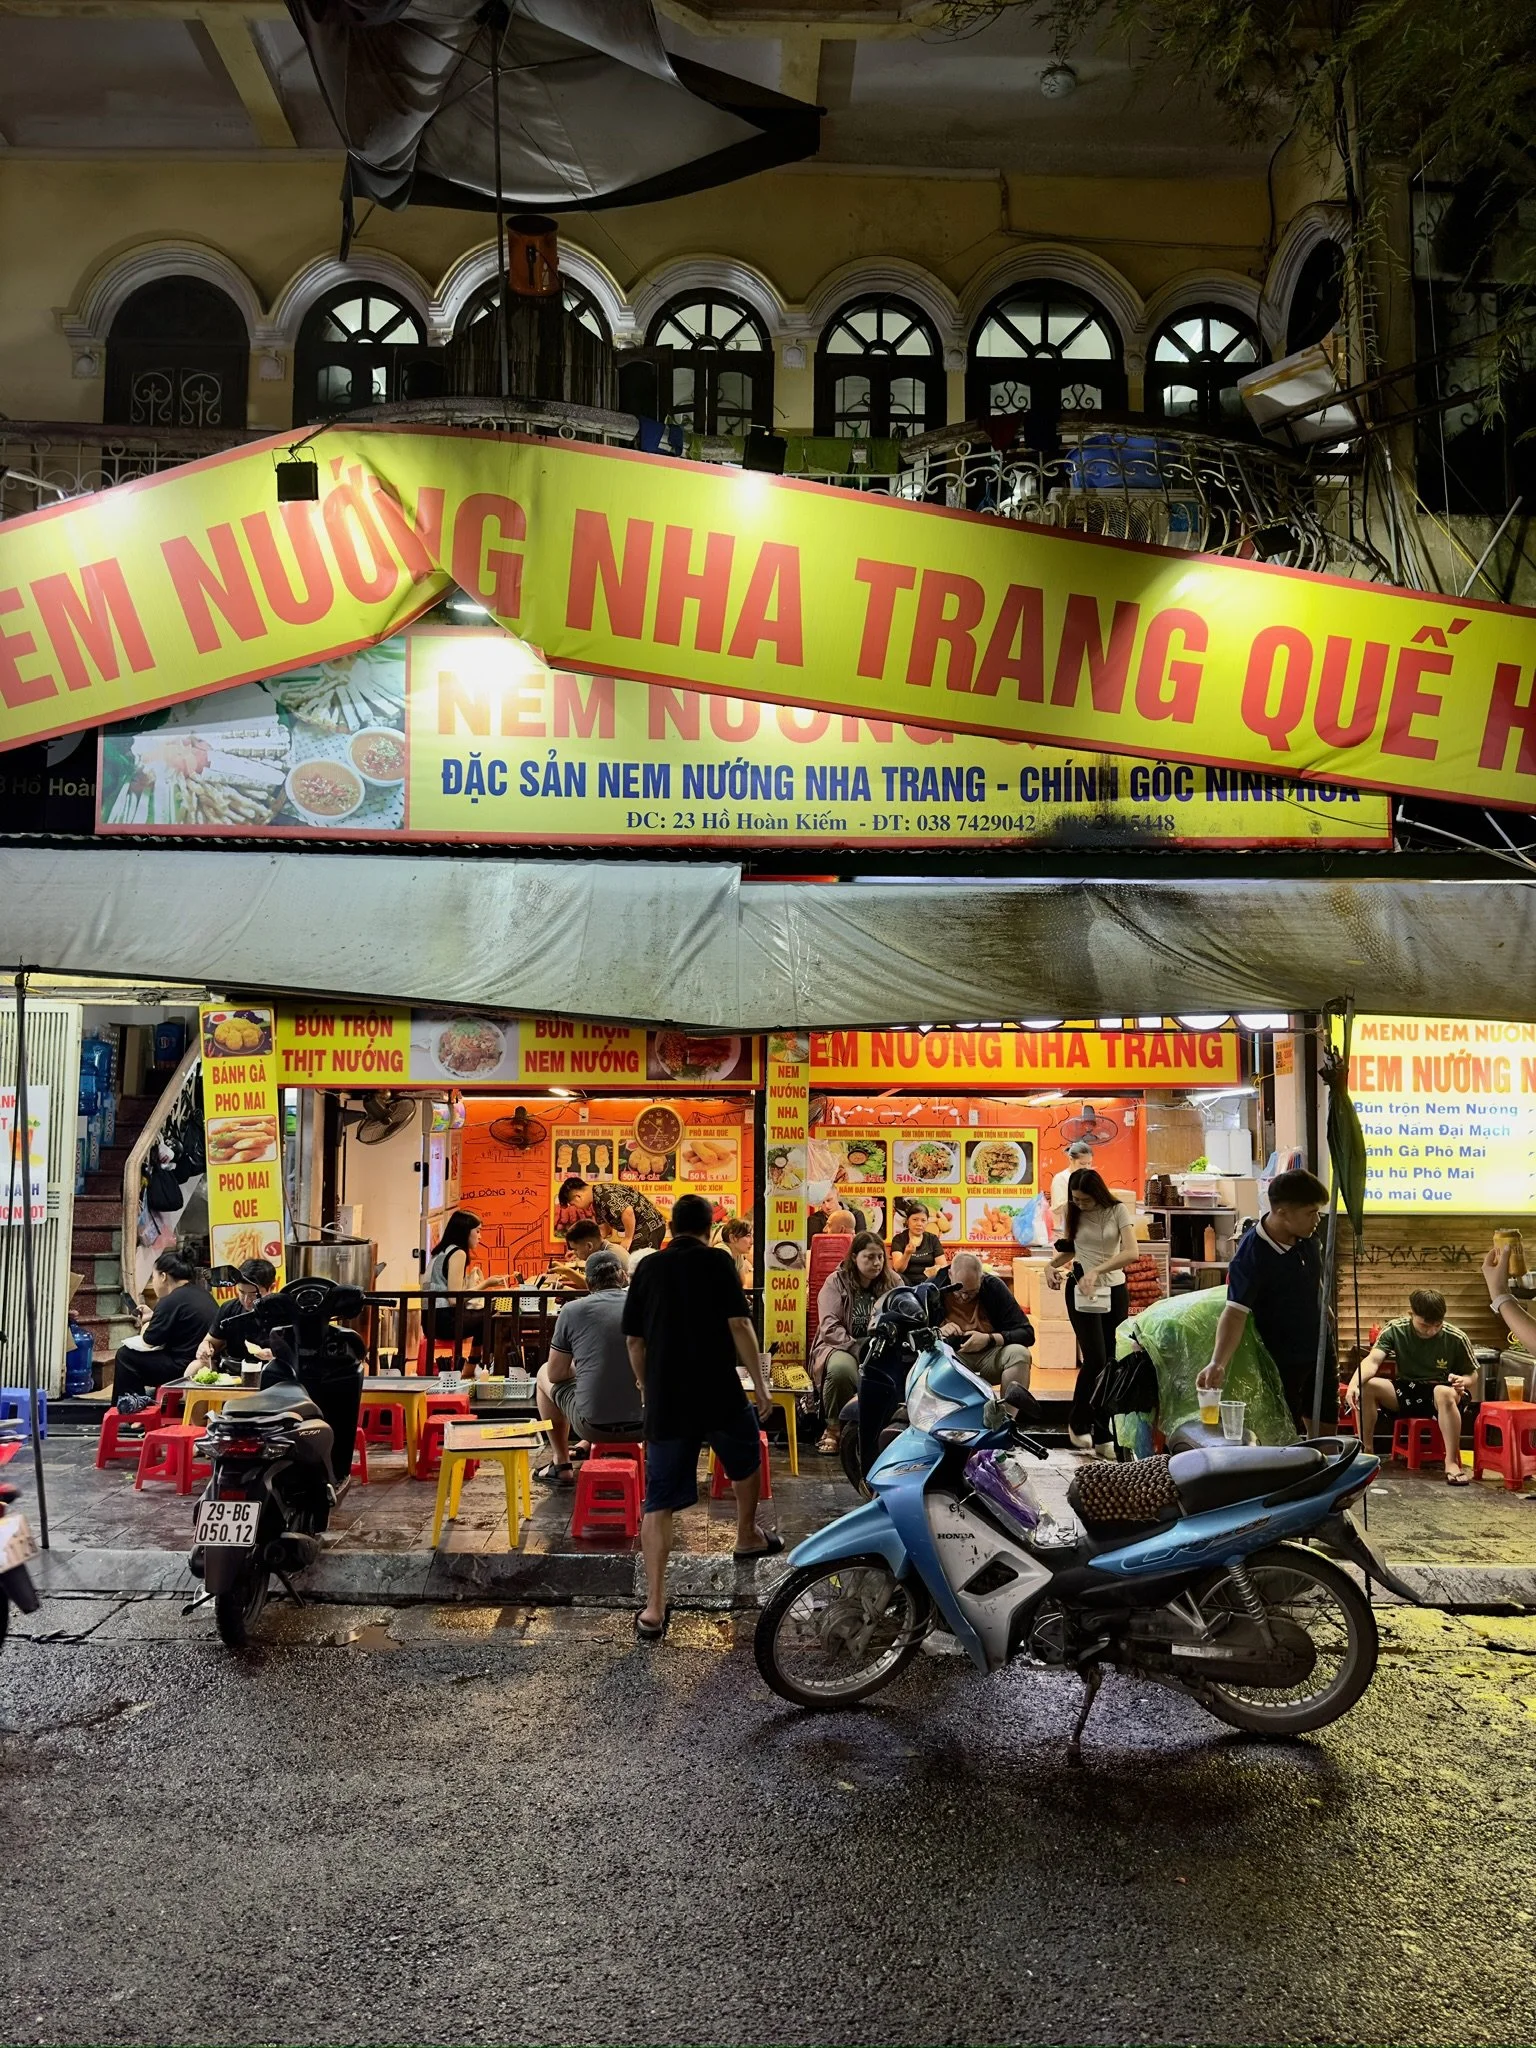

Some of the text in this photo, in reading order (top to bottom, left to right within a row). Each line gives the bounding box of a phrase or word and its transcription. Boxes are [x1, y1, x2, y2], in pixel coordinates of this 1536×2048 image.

[565, 510, 803, 667] NHA
[855, 558, 1209, 724] TRANG
[1241, 618, 1472, 761] QUẾ
[438, 671, 615, 740] NEM
[442, 751, 507, 804] ĐẶC
[519, 749, 586, 799] SẢN
[598, 762, 671, 799] NEM
[683, 757, 793, 801] NƯỚNG
[805, 765, 868, 802] NHA
[881, 766, 986, 803] TRANG
[626, 812, 666, 830] ĐC:
[673, 812, 695, 830] 23
[702, 809, 730, 831] Hồ
[736, 812, 788, 831] Hoàn
[797, 810, 847, 832] Kiếm
[872, 813, 910, 832] ĐT:
[917, 815, 951, 832] 038
[956, 815, 1036, 832] 7429042
[295, 1008, 393, 1043] BÚN TRỘN
[1360, 1023, 1419, 1041] MENU
[1425, 1024, 1469, 1042] NEM
[282, 1044, 404, 1077] THỊT NƯỚNG
[525, 1045, 639, 1074] NEM NƯỚNG
[1015, 1033, 1090, 1069] NHA
[1100, 1033, 1224, 1069] TRANG
[212, 1059, 267, 1085] BÁNH GÀ
[777, 1065, 800, 1079] NEM
[1412, 1049, 1511, 1093] NƯỚNG
[769, 1083, 807, 1099] NƯỚNG
[215, 1091, 266, 1112] PHO MAI
[1426, 1103, 1460, 1114] Nem
[777, 1106, 799, 1119] NHA
[703, 1129, 715, 1137] MAI
[717, 1129, 728, 1138] QUE
[770, 1126, 805, 1140] TRANG
[1439, 1124, 1463, 1139] Đại
[1469, 1124, 1511, 1140] Mạch
[1365, 1145, 1393, 1157] ánh
[1459, 1146, 1486, 1157] Mai
[248, 1170, 270, 1190] MAI
[1365, 1166, 1384, 1181] ậu
[1447, 1167, 1475, 1179] Mai
[1388, 1189, 1417, 1200] mai
[1422, 1188, 1452, 1201] Que
[233, 1198, 258, 1219] QUE
[775, 1201, 798, 1214] NEM
[778, 1219, 795, 1236] LỤI
[771, 1274, 800, 1291] CHÁO
[774, 1294, 797, 1312] NẤM
[776, 1319, 794, 1336] ĐẠI
[207, 1503, 251, 1522] 29-BG
[199, 1523, 253, 1543] 050.12
